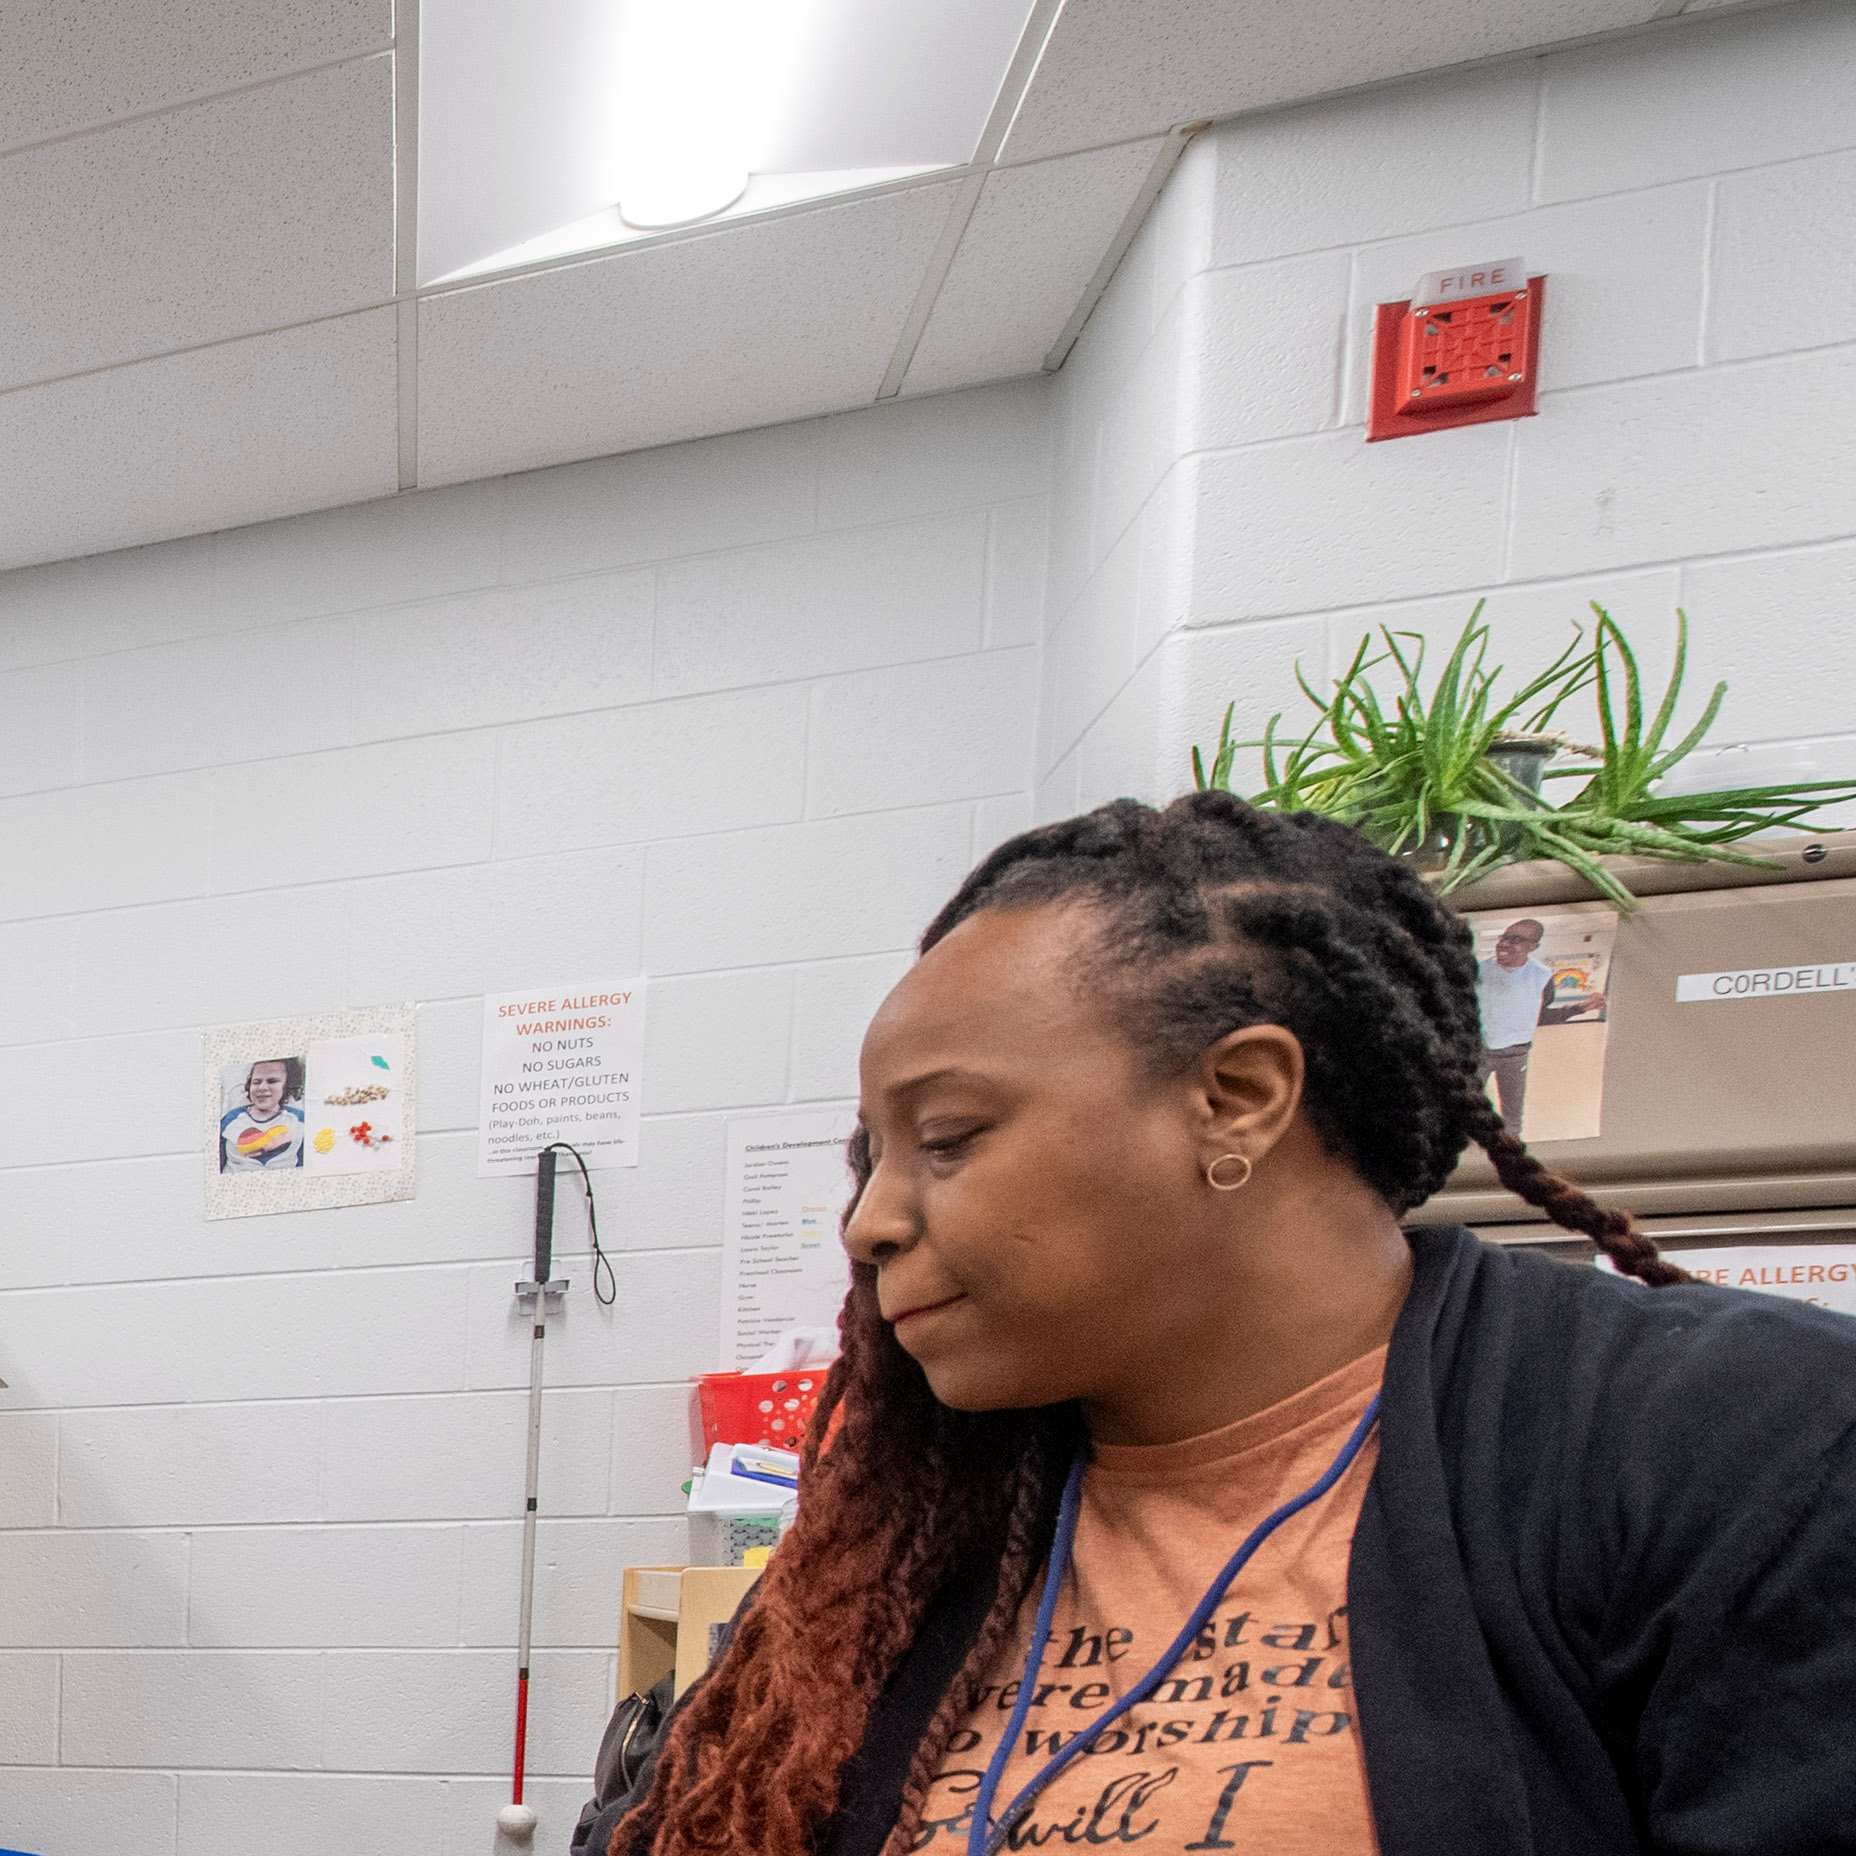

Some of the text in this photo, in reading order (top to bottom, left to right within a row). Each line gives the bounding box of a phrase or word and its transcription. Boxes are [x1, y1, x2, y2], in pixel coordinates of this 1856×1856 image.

[1440, 268, 1505, 293] FIRE
[498, 992, 632, 1018] SEVERE ALLERGY
[516, 1015, 612, 1036] WARNINGS:
[532, 1037, 594, 1053] NO NUTS
[522, 1055, 601, 1073] NO SUGARS
[494, 1073, 629, 1095] NO WHEAT/GLUTEN
[492, 1091, 630, 1113] FOODS OR PRODUCTS
[1739, 1263, 1856, 1286] ALLERG
[1026, 1625, 1133, 1668] he
[1025, 1695, 1351, 1756] worship
[1006, 1767, 1180, 1852] will
[1185, 1760, 1273, 1851] I
